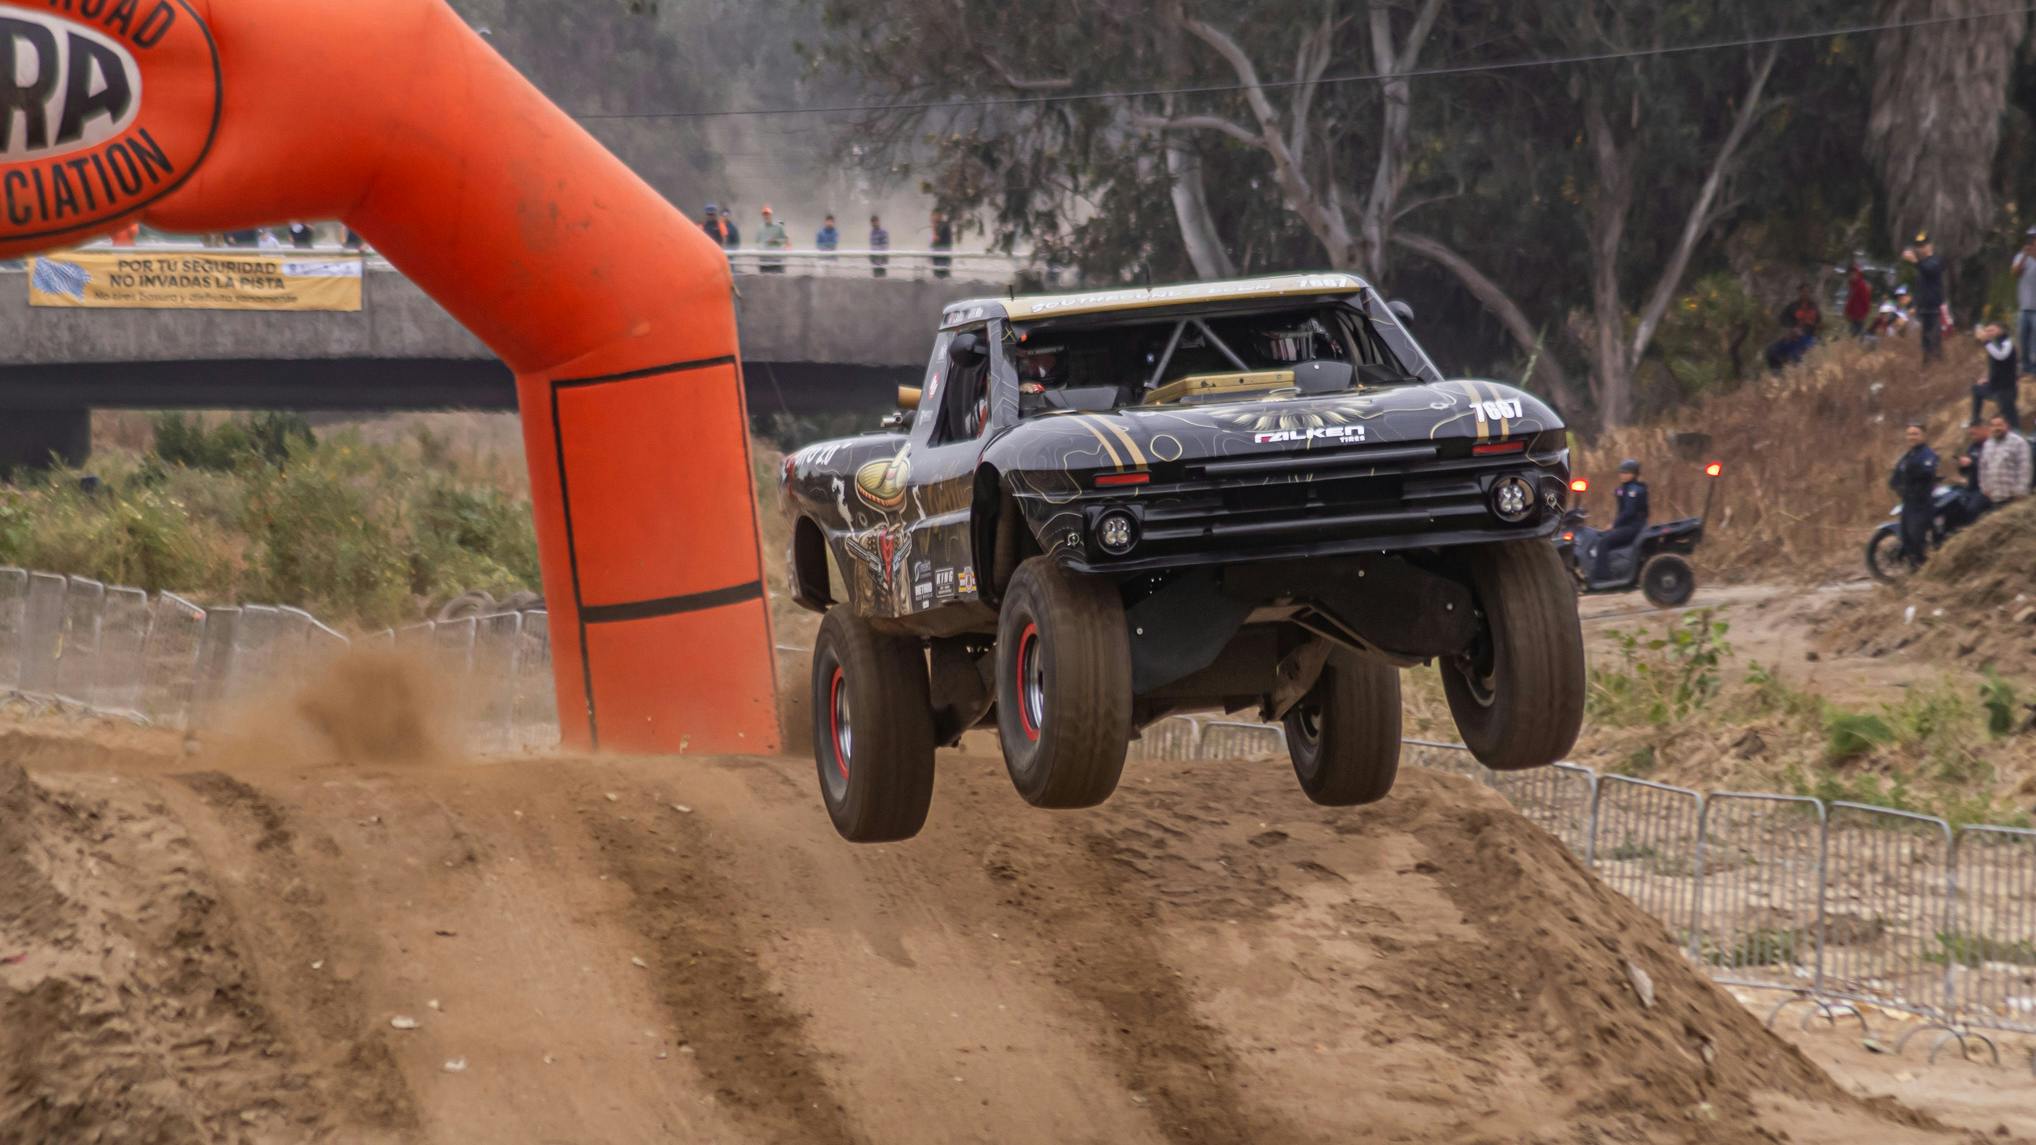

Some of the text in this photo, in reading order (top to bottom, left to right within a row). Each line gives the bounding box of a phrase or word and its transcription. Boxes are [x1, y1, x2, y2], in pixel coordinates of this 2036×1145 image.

[50, 0, 176, 48] OAD
[0, 16, 132, 153] RA
[3, 128, 175, 226] CIATION
[118, 260, 153, 273] POR
[158, 260, 178, 273] TU
[182, 260, 277, 275] SEGURIDAD
[110, 274, 286, 290] NO INVADAS LA PISTA
[1254, 425, 1365, 443] FALKEN
[936, 570, 953, 585] KING
